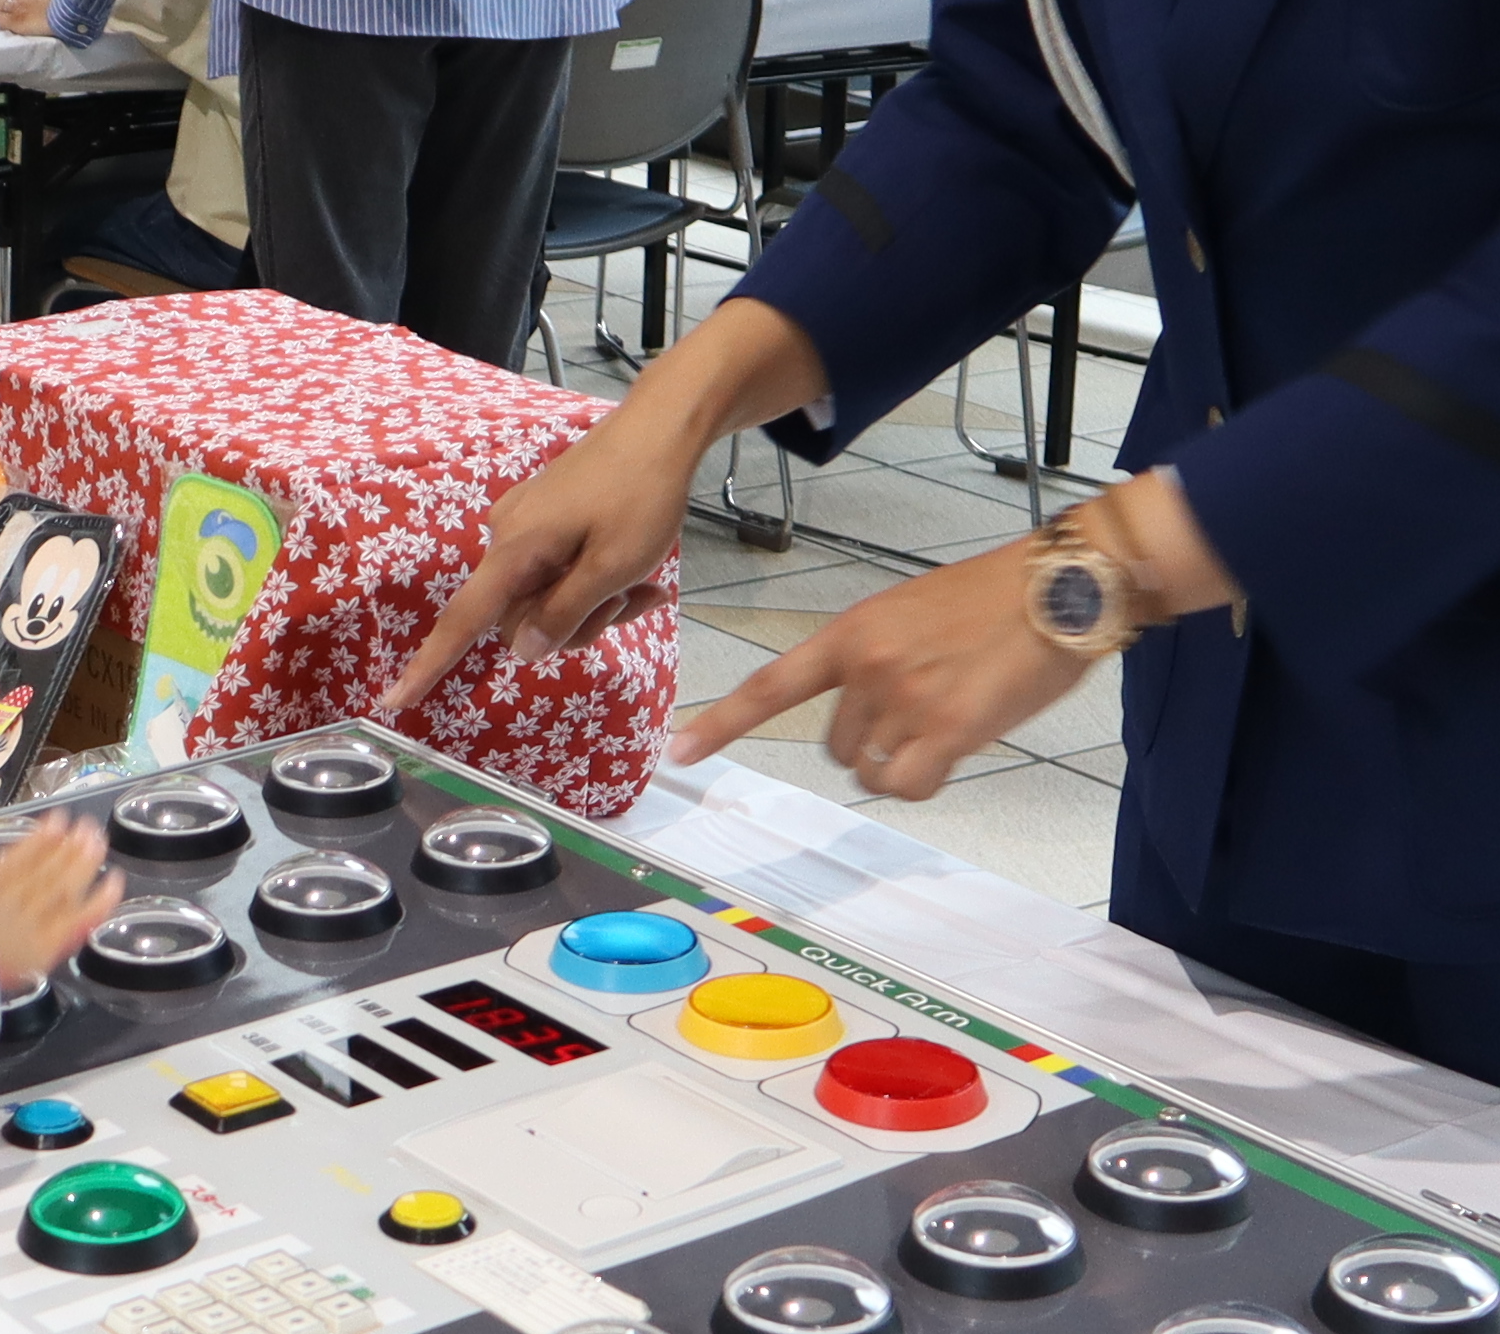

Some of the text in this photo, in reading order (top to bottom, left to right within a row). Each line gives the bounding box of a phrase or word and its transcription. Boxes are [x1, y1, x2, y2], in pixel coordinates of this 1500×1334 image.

[801, 946, 970, 1028] Quick Arm
[180, 1185, 239, 1217] スタート
